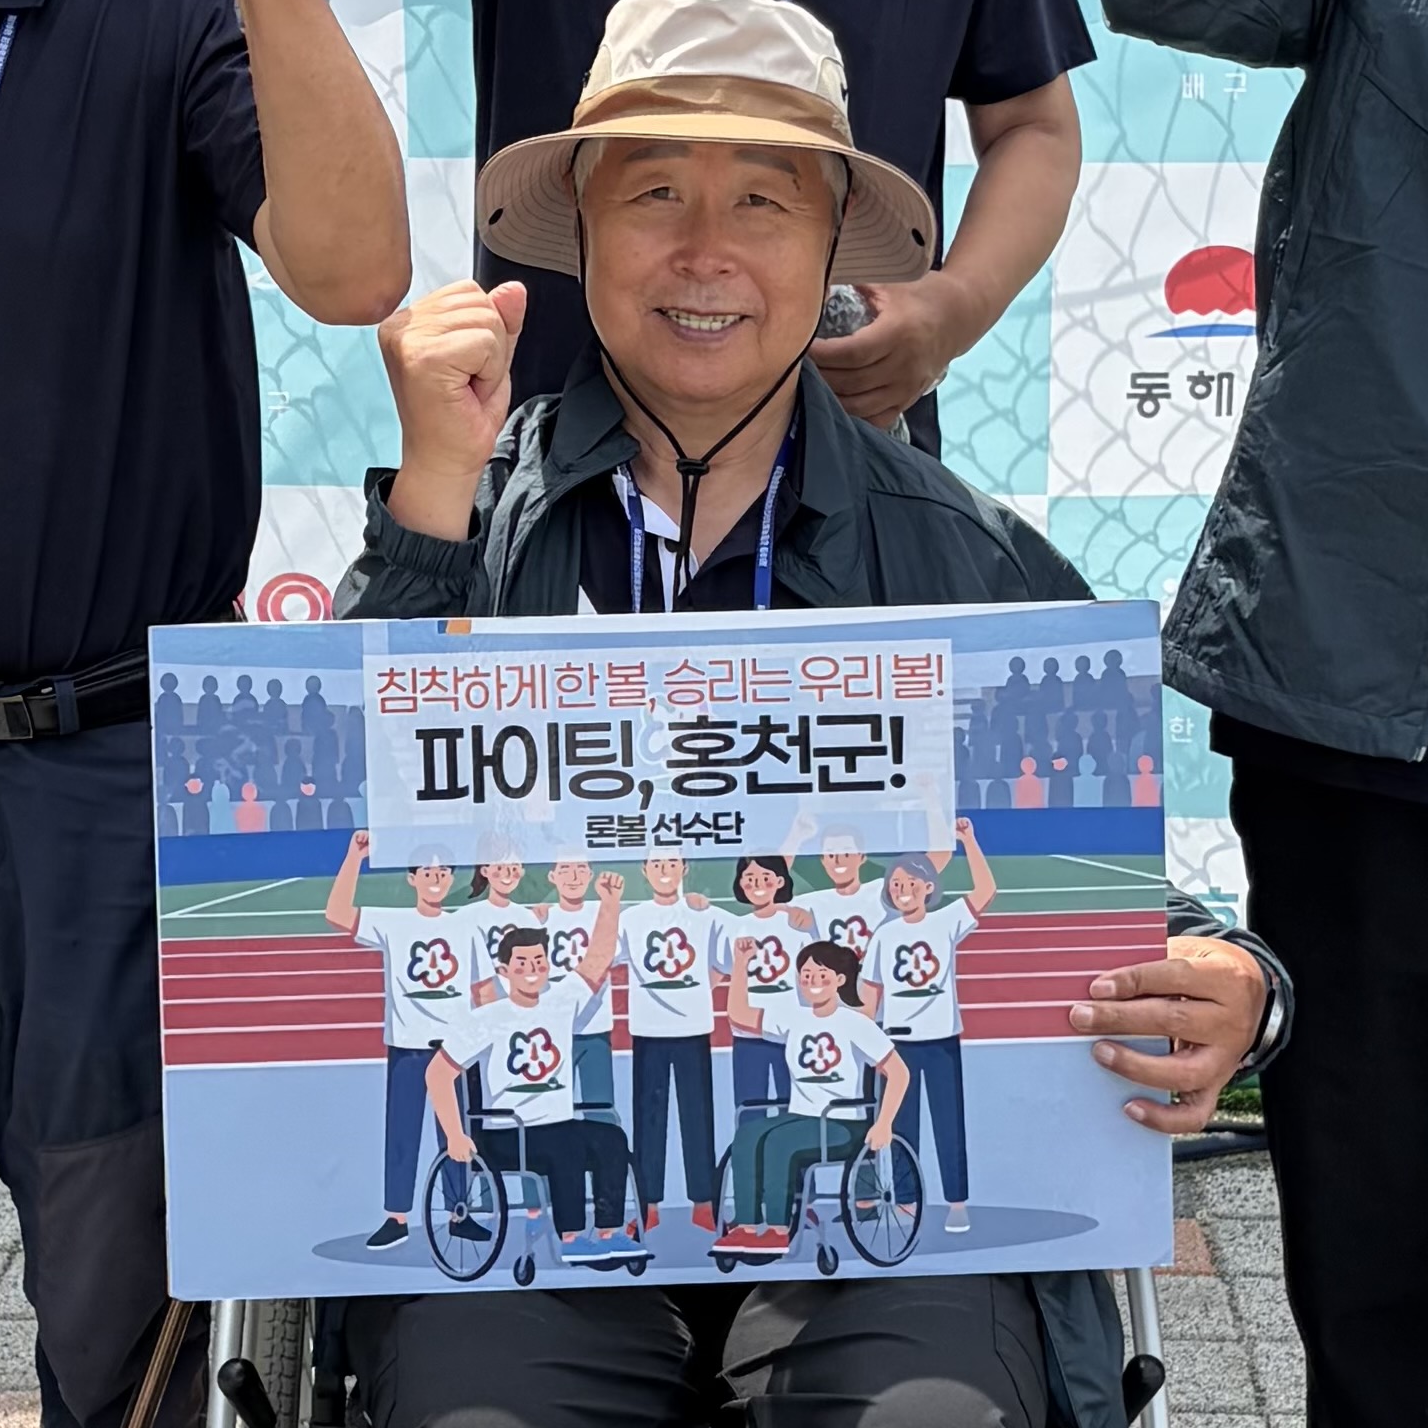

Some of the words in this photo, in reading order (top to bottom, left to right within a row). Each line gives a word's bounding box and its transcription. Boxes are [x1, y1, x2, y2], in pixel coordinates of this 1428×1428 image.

[1126, 370, 1235, 419] 동해
[375, 664, 548, 714] 침착하게
[554, 660, 598, 709] 한
[604, 659, 658, 716] 볼,
[662, 654, 793, 706] 승리는
[798, 653, 883, 703] 우리
[891, 651, 945, 700] 볼!
[664, 713, 907, 797] 홍천군!
[584, 813, 648, 849] 론볼
[651, 811, 744, 846] 선수단
